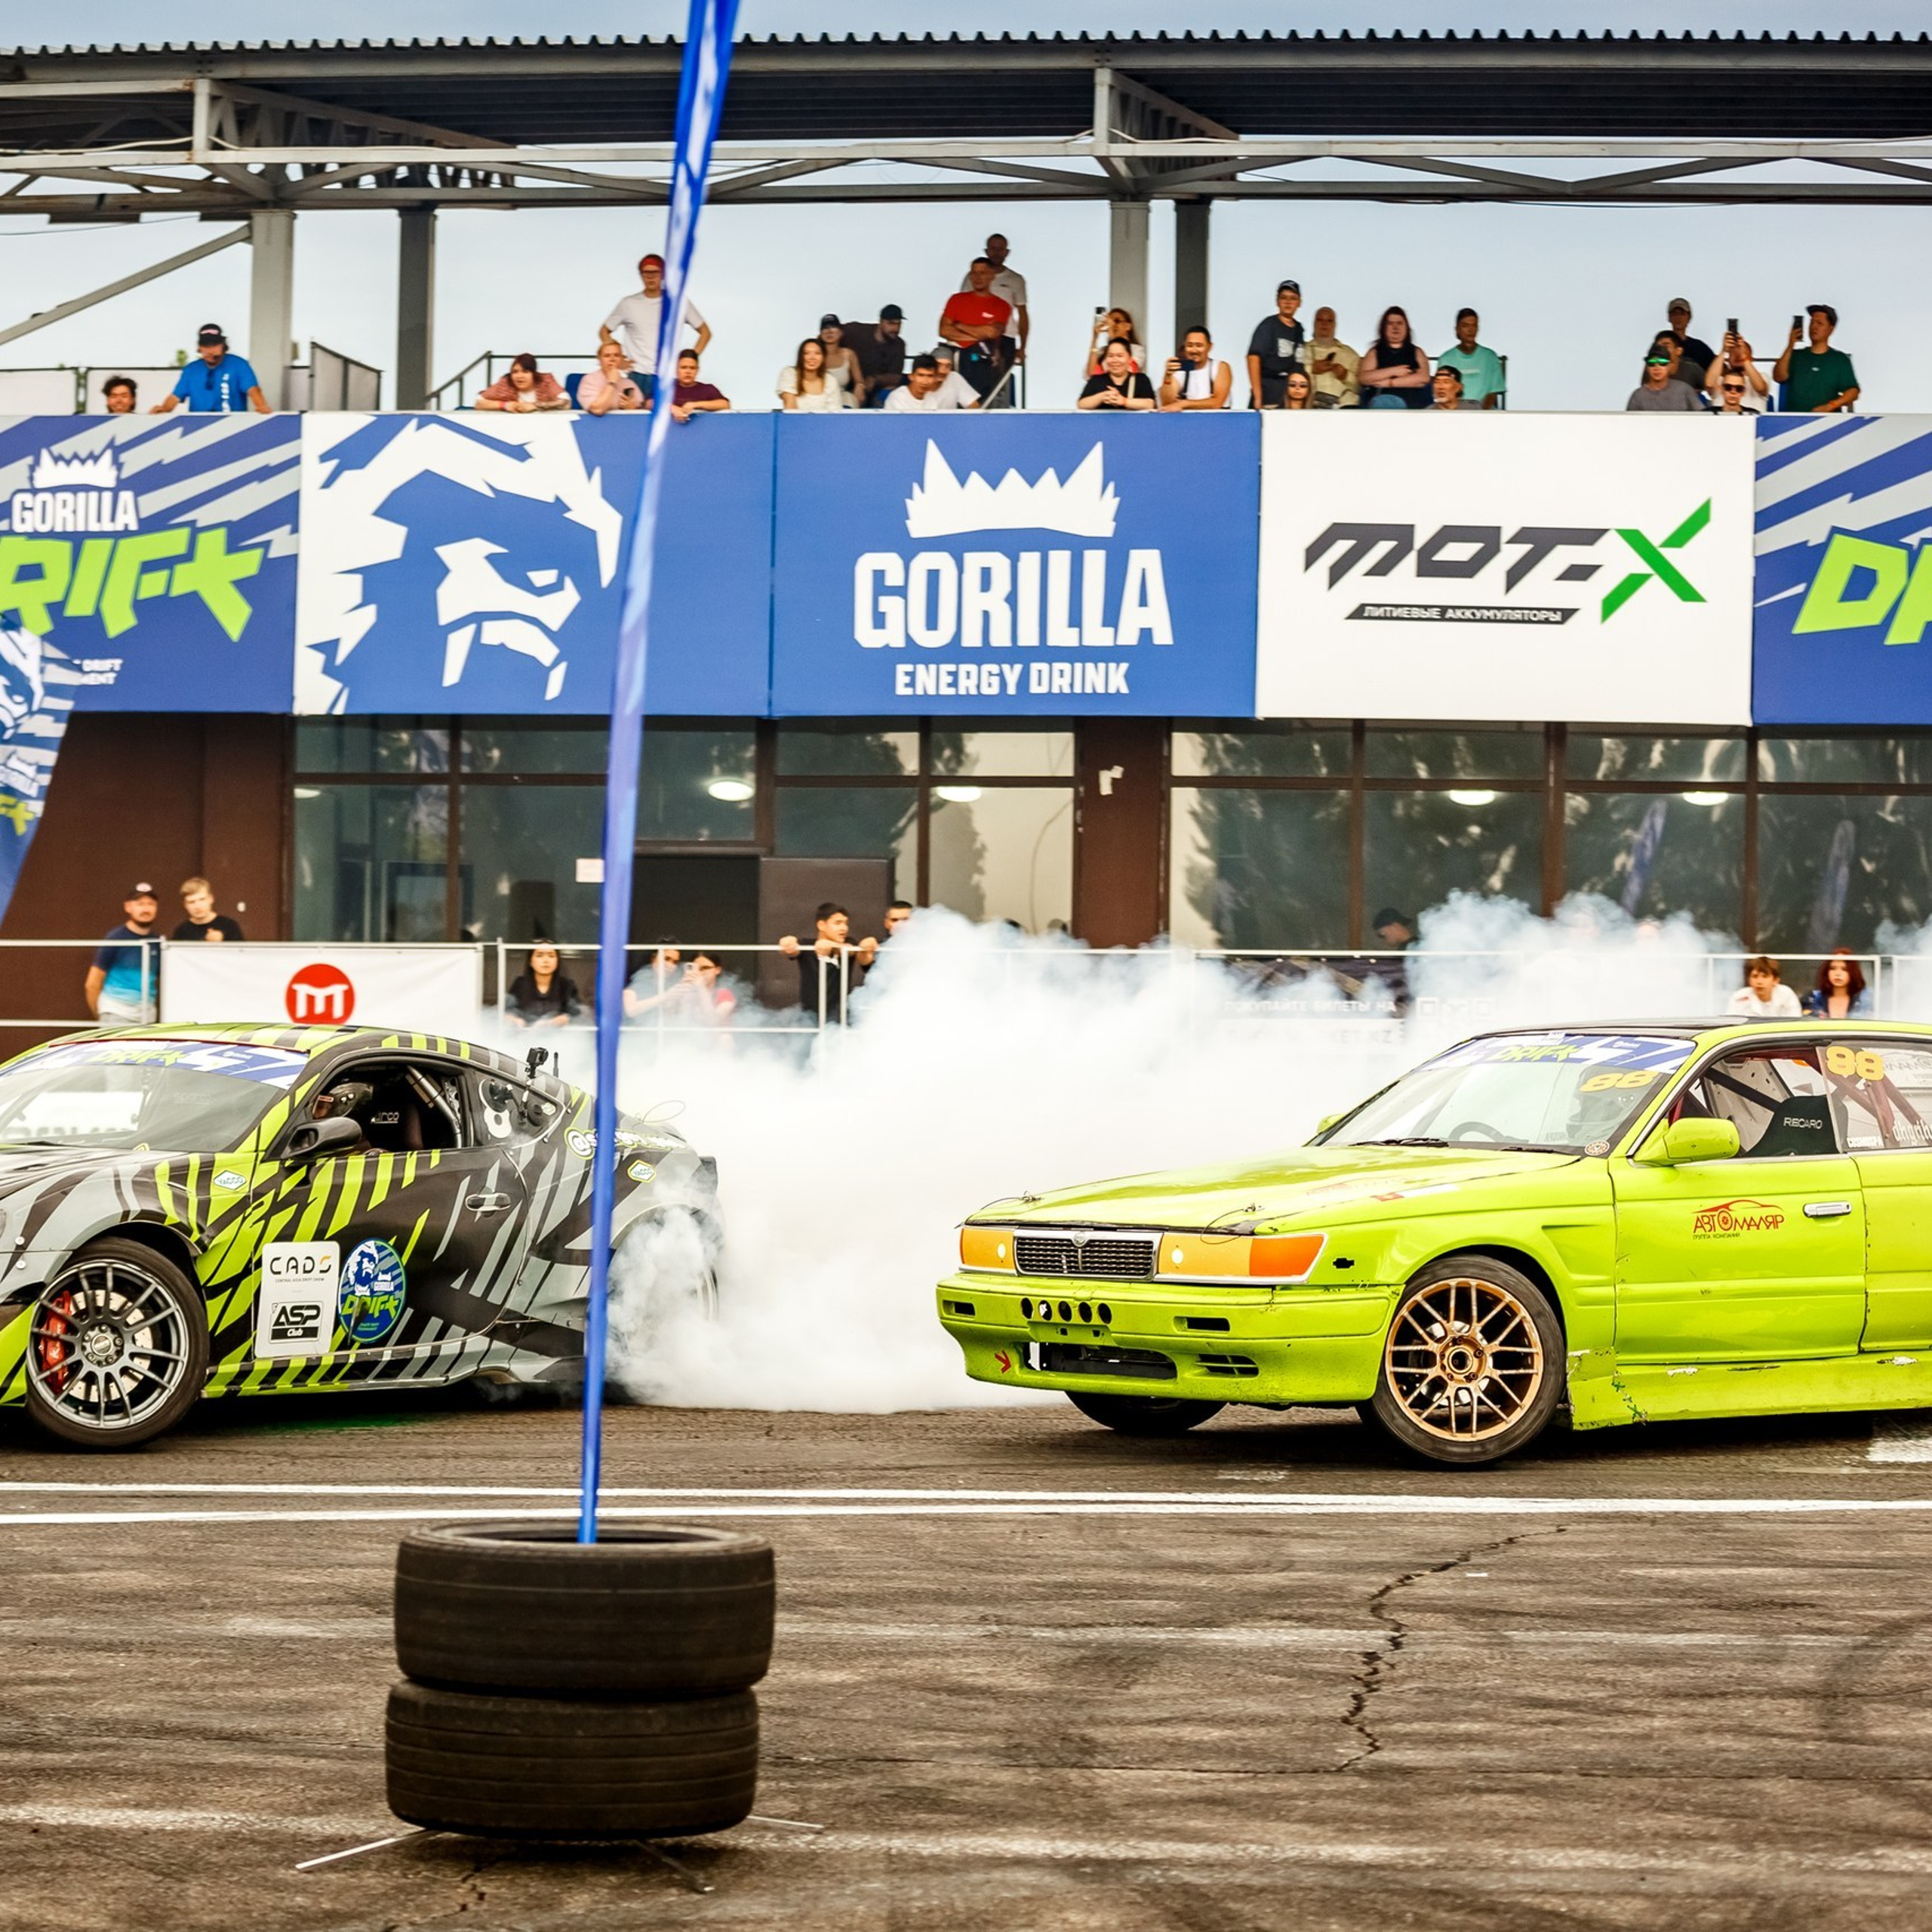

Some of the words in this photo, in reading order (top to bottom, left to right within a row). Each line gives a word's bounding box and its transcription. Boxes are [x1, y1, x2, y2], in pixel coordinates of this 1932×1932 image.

[12, 491, 139, 533] GORILLA
[854, 549, 1174, 648] GORILLA
[1363, 606, 1441, 620] ЛИТИЕВЫЕ
[1444, 608, 1562, 621] АККУМУЛЯТОРЫ
[895, 663, 1023, 696] ENERGY
[1029, 662, 1130, 694] DRINK
[1314, 1001, 1371, 1012] БИЛЕТЫ
[1376, 1001, 1397, 1012] НА
[1826, 1046, 1884, 1081] 88
[1580, 1070, 1660, 1092] 88
[1783, 1117, 1823, 1130] RECARO
[1693, 1210, 1785, 1234] АВТОМАЛЯР
[269, 1256, 332, 1275] CADS
[272, 1305, 321, 1327] ASP
[287, 1327, 303, 1337] Club
